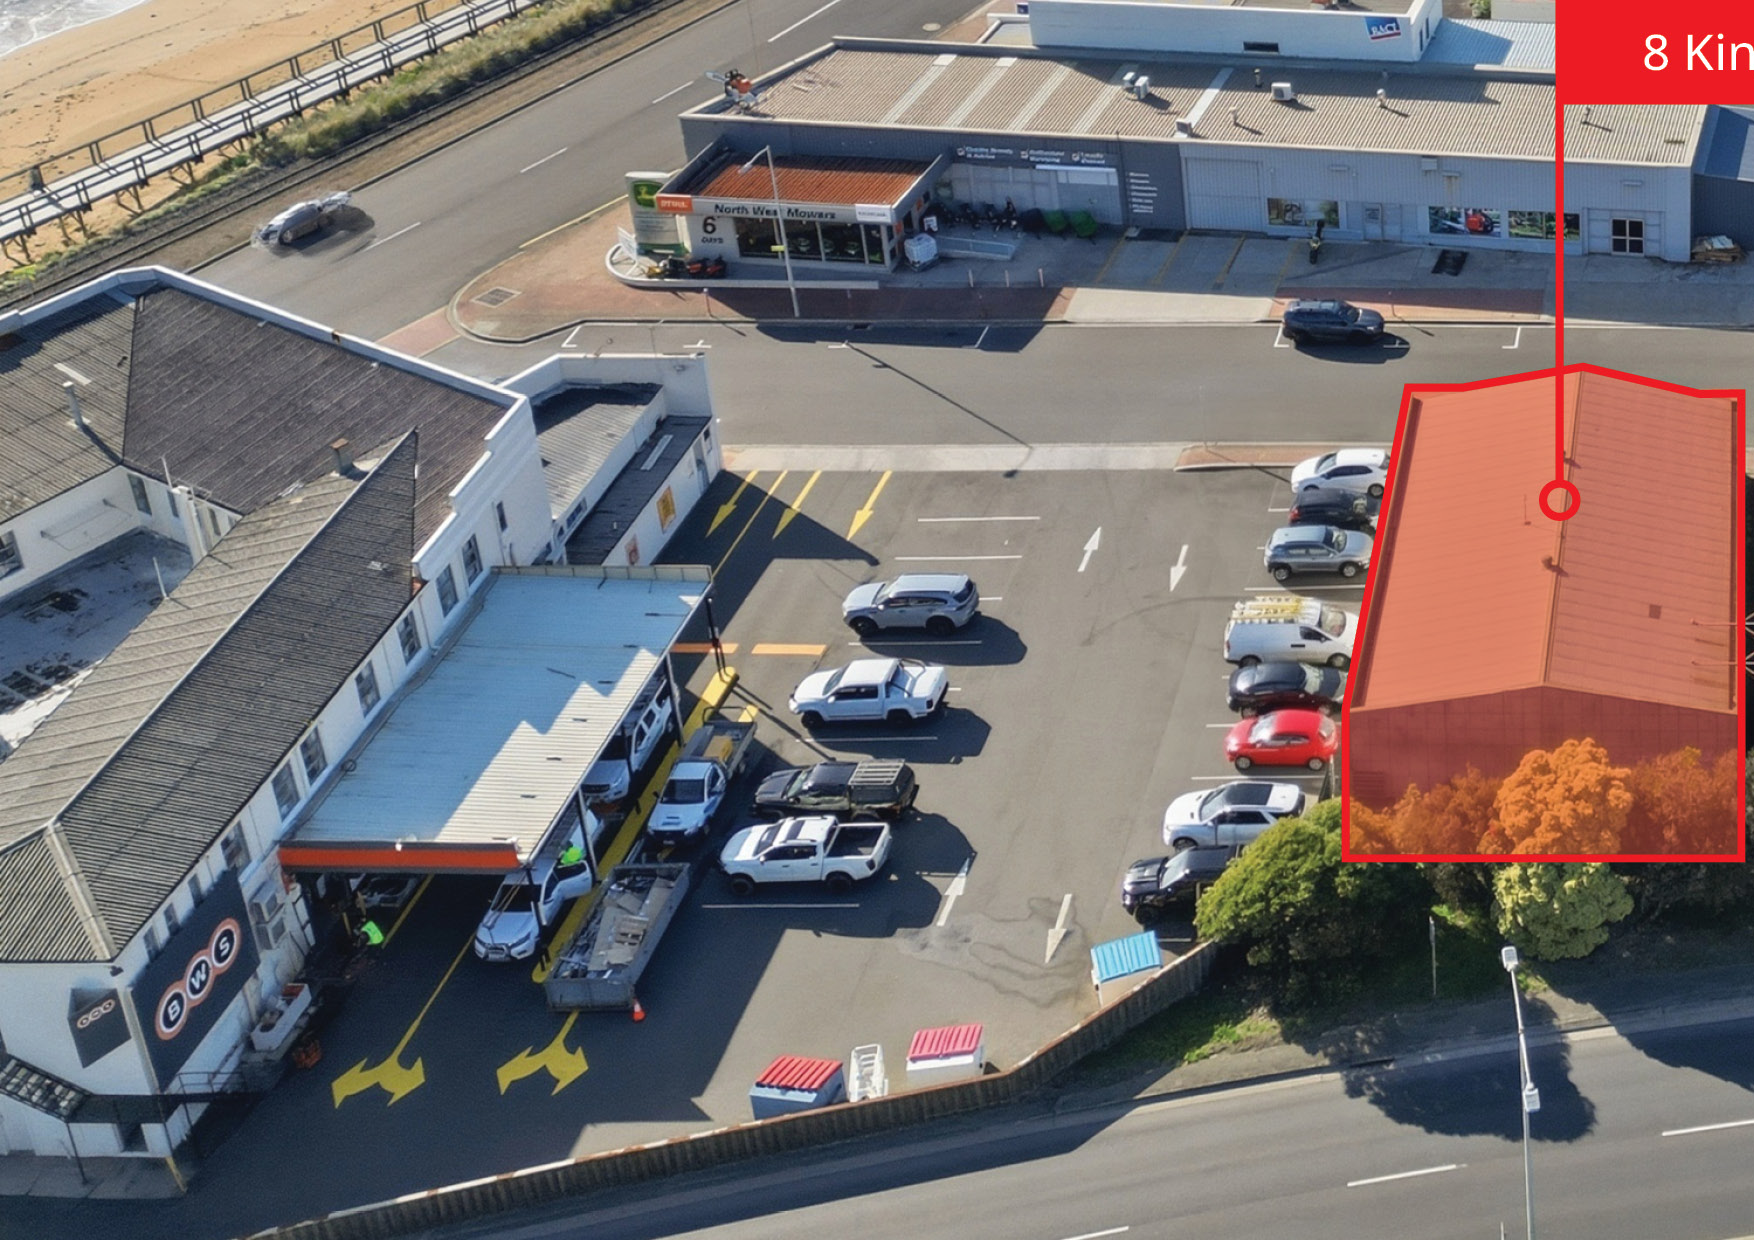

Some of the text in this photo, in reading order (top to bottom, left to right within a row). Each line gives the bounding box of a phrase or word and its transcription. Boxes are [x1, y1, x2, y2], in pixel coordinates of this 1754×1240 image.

[714, 203, 749, 216] North
[787, 206, 836, 220] Mowers
[702, 216, 717, 235] 6
[161, 931, 234, 1029] BWS
